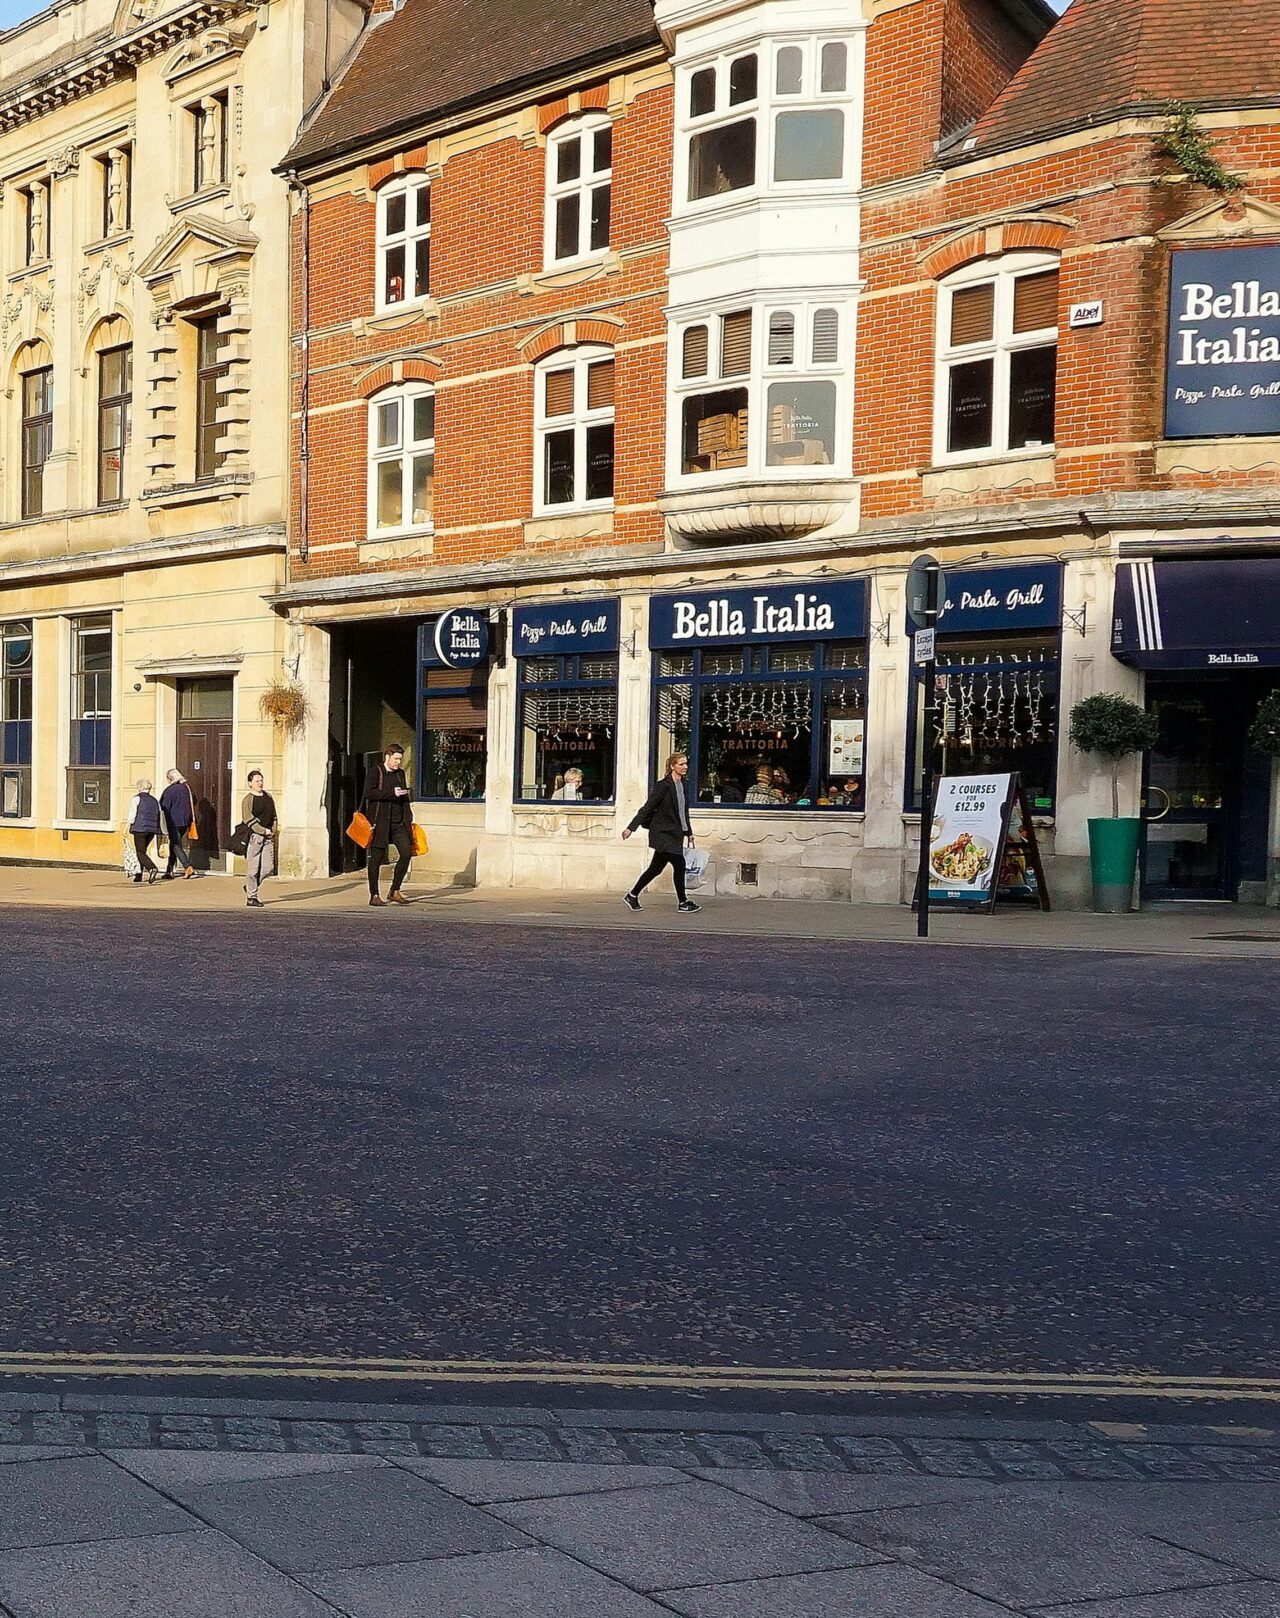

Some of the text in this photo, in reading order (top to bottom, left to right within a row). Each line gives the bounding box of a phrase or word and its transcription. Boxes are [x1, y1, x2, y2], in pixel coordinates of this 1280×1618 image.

[1179, 280, 1280, 321] Bella
[1176, 326, 1280, 366] Italia
[1175, 381, 1280, 404] Pizza Pasta Grill
[961, 589, 1000, 609] Pasta
[1006, 584, 1044, 610] Grill
[451, 616, 480, 631] Bella
[672, 593, 834, 639] Bella Italia
[521, 616, 607, 644] Pizza Pasta Grill
[450, 633, 480, 648] Italia
[1208, 653, 1259, 664] Bella Italia
[539, 741, 596, 751] TRATTORIA
[722, 739, 788, 749] TRATTORIA
[950, 784, 997, 795] 2 COURSES
[955, 801, 985, 811] £12.99
